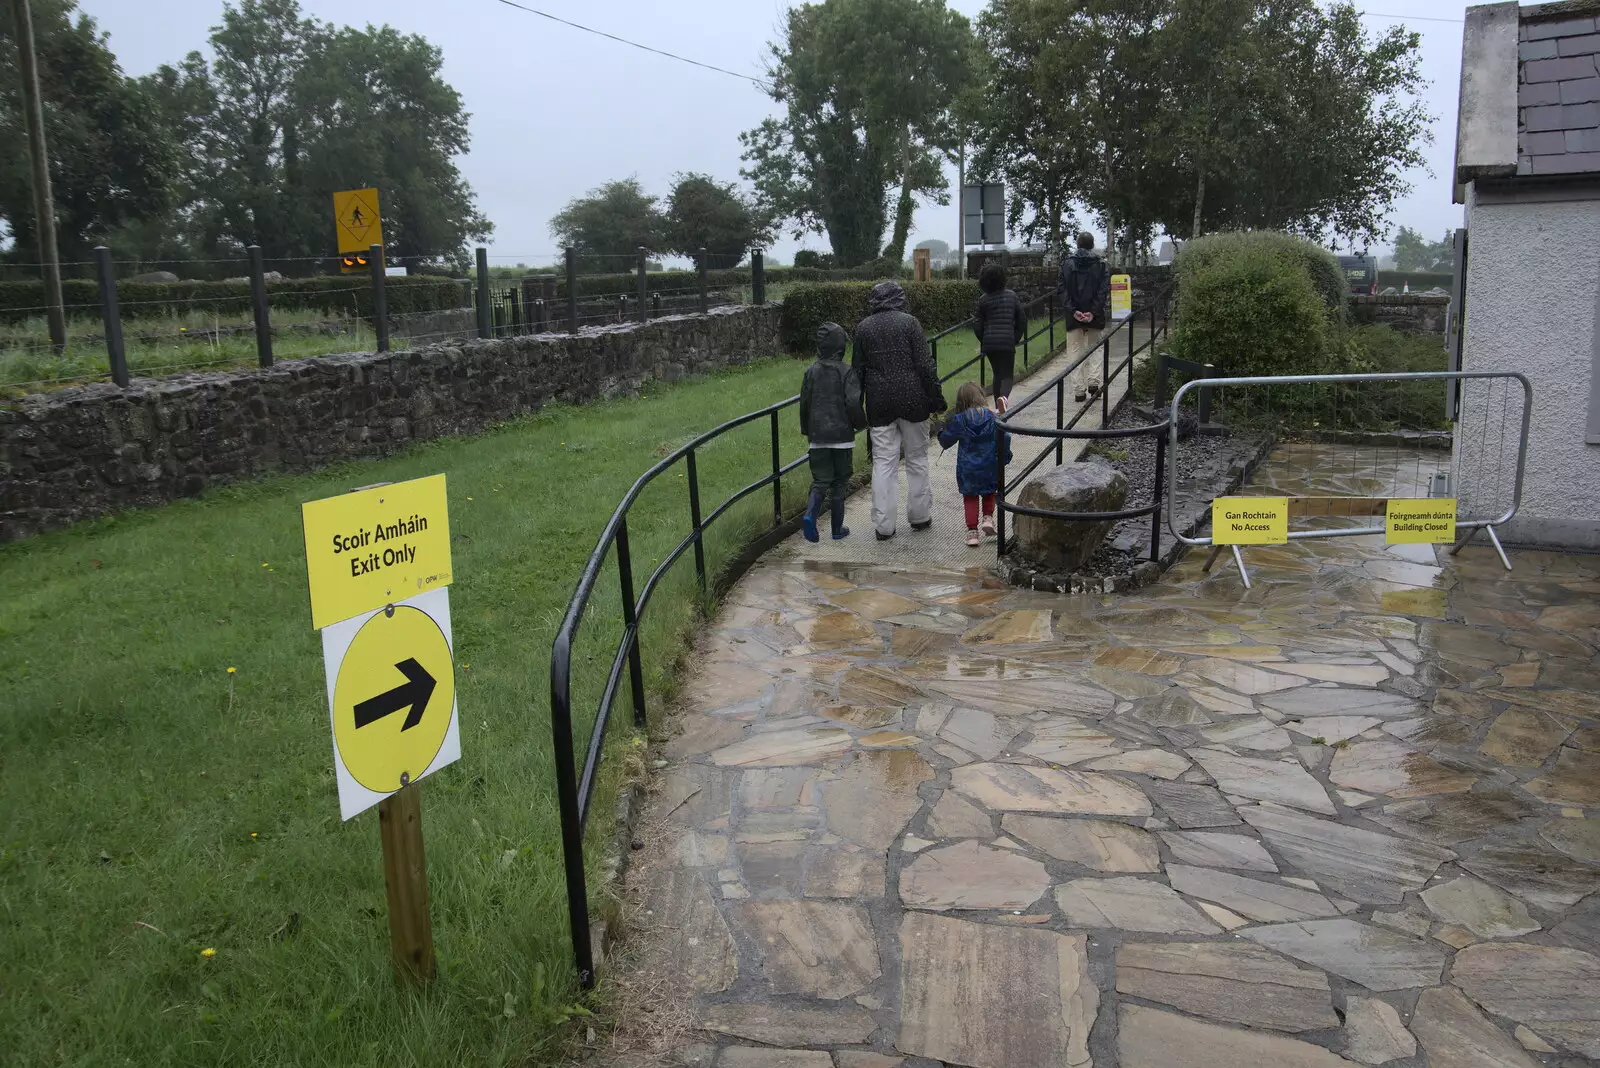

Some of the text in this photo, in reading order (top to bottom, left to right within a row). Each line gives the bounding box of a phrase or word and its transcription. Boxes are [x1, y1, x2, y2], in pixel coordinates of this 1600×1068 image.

[1225, 510, 1277, 520] Gan Rochtain
[1389, 511, 1453, 521] Foirgneamh dúnta
[1231, 523, 1270, 531] No Access
[1393, 522, 1448, 533] Building Closed
[332, 513, 428, 554] Scoir Amháin
[350, 543, 416, 577] Exit Only
[425, 574, 438, 584] OPW
